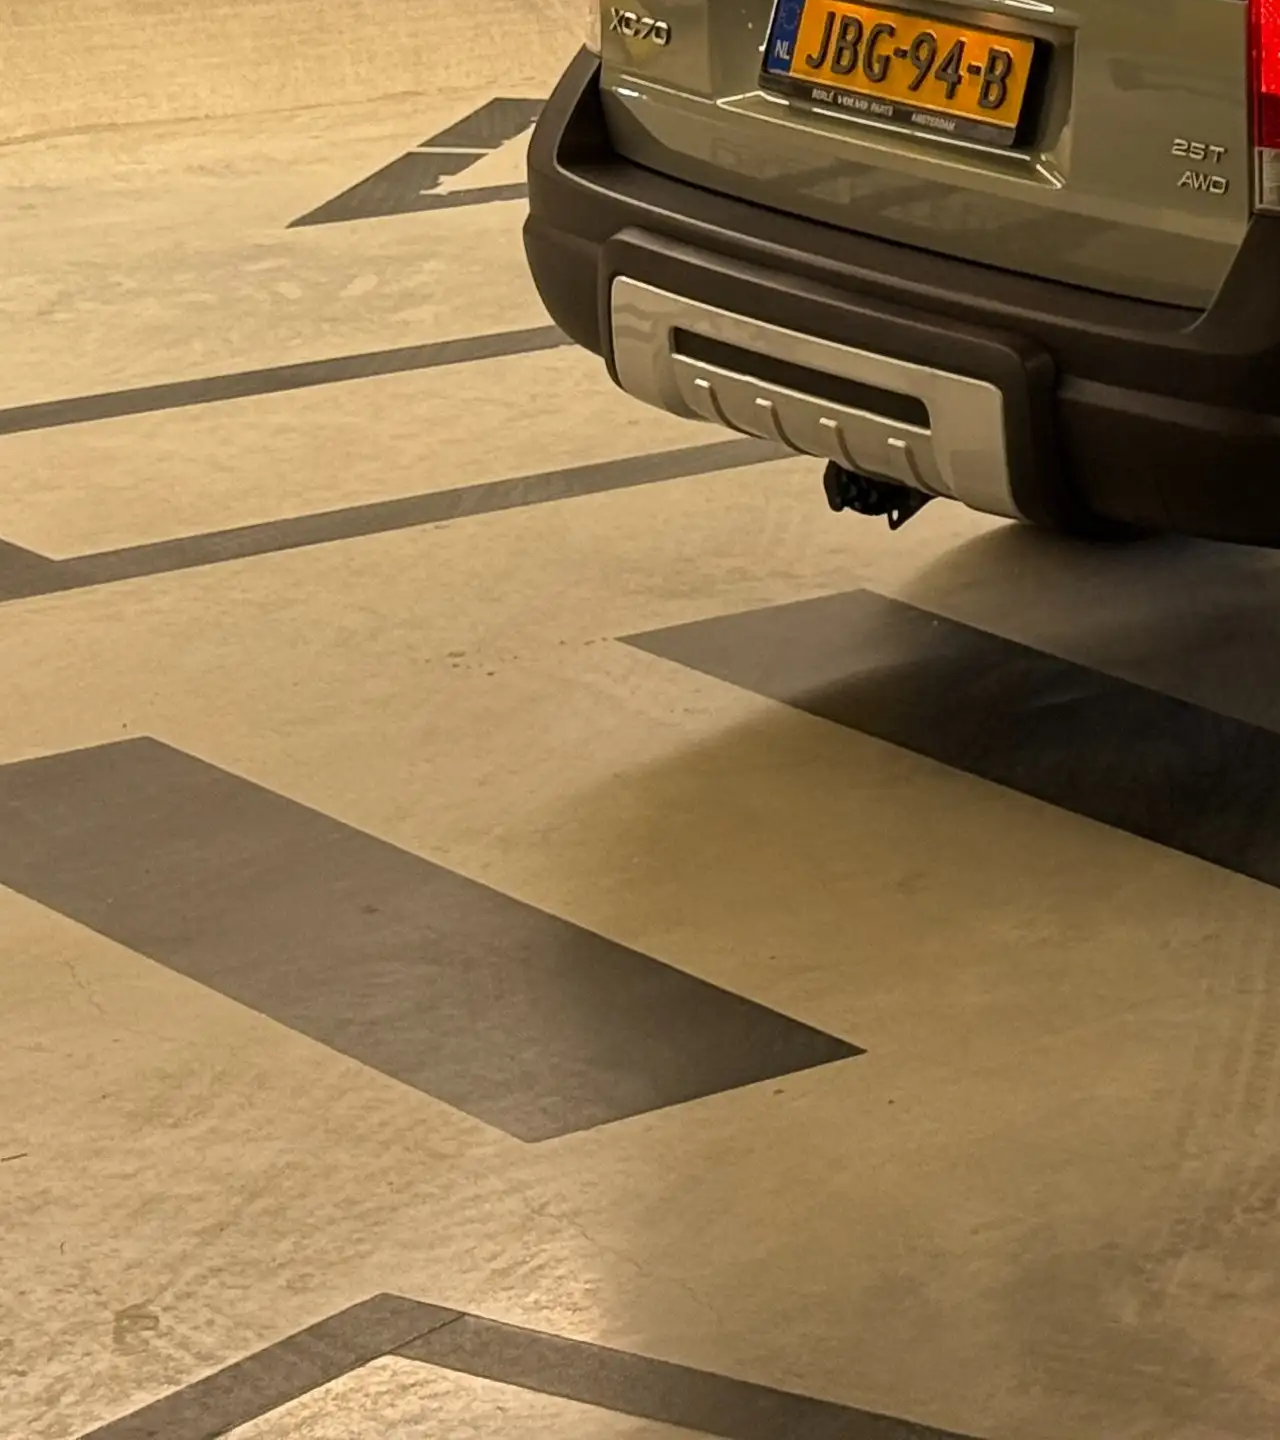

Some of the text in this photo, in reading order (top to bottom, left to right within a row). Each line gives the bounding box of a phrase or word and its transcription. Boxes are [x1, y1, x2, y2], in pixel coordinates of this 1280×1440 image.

[609, 6, 671, 47] XC70
[774, 38, 791, 61] NL
[805, 10, 1014, 111] JBG-94-B
[837, 94, 869, 111] VOLVO
[1176, 169, 1230, 195] AWD
